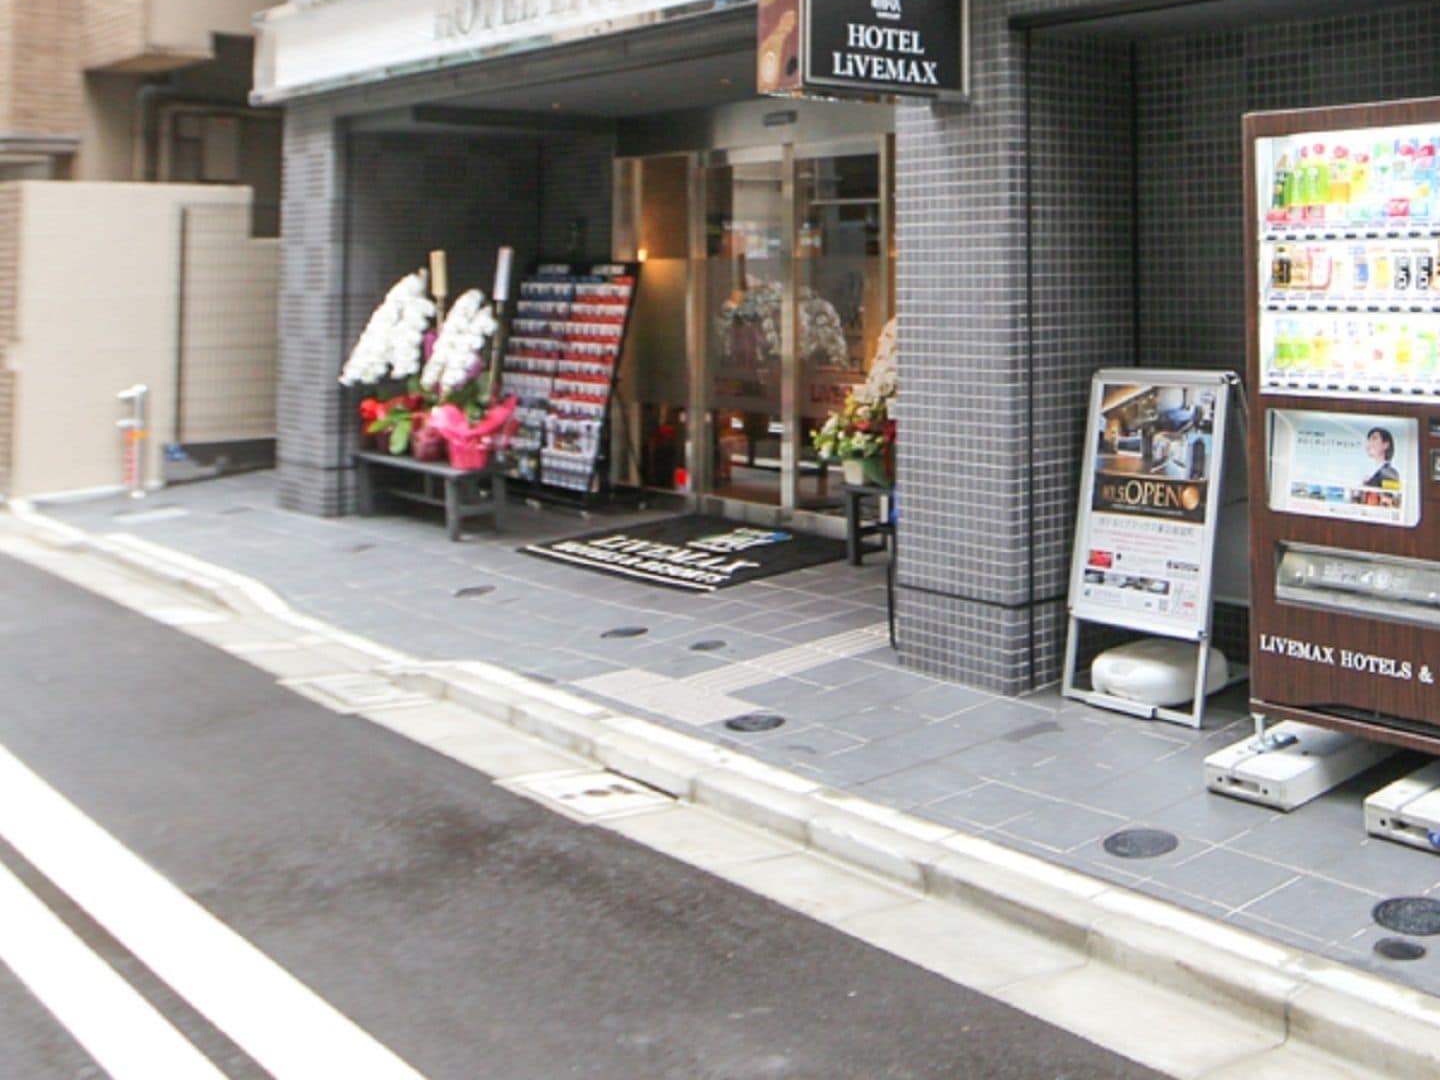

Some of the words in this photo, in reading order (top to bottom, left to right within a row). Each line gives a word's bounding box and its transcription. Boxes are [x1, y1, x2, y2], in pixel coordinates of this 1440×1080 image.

[846, 22, 926, 55] HOTEL
[1125, 479, 1183, 508] OPEN
[1340, 650, 1413, 680] HOTELS
[1418, 664, 1434, 684] &
